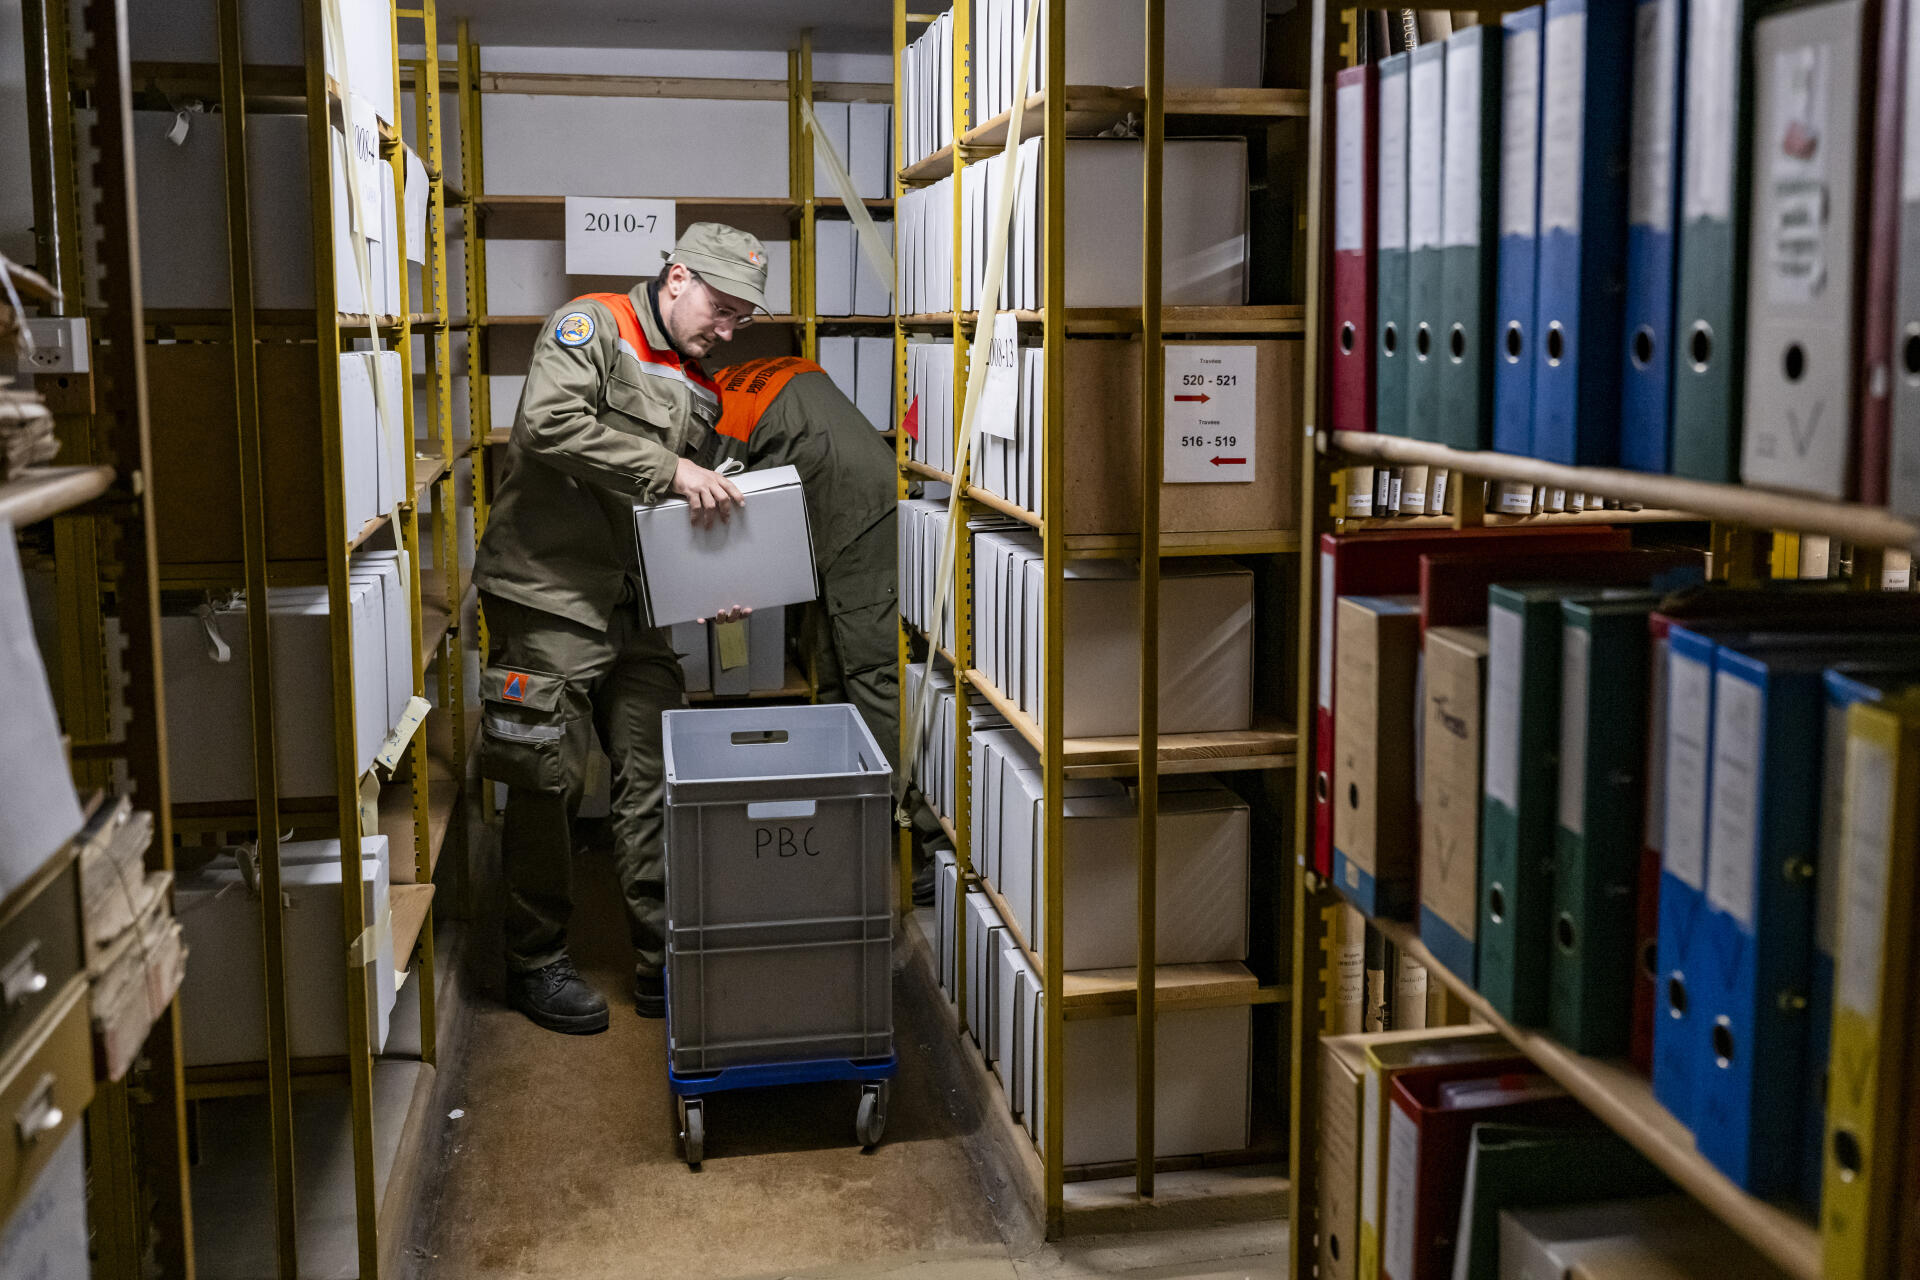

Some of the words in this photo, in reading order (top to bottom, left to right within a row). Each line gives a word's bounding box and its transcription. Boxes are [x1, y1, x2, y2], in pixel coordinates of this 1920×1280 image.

[354, 124, 376, 165] 008-4
[584, 212, 657, 234] 2010-7
[986, 337, 1016, 368] 008-13
[1183, 374, 1204, 386] 520
[1216, 375, 1237, 386] 521
[1181, 436, 1203, 447] 516
[1215, 436, 1237, 447] 519
[756, 826, 820, 859] PBC
